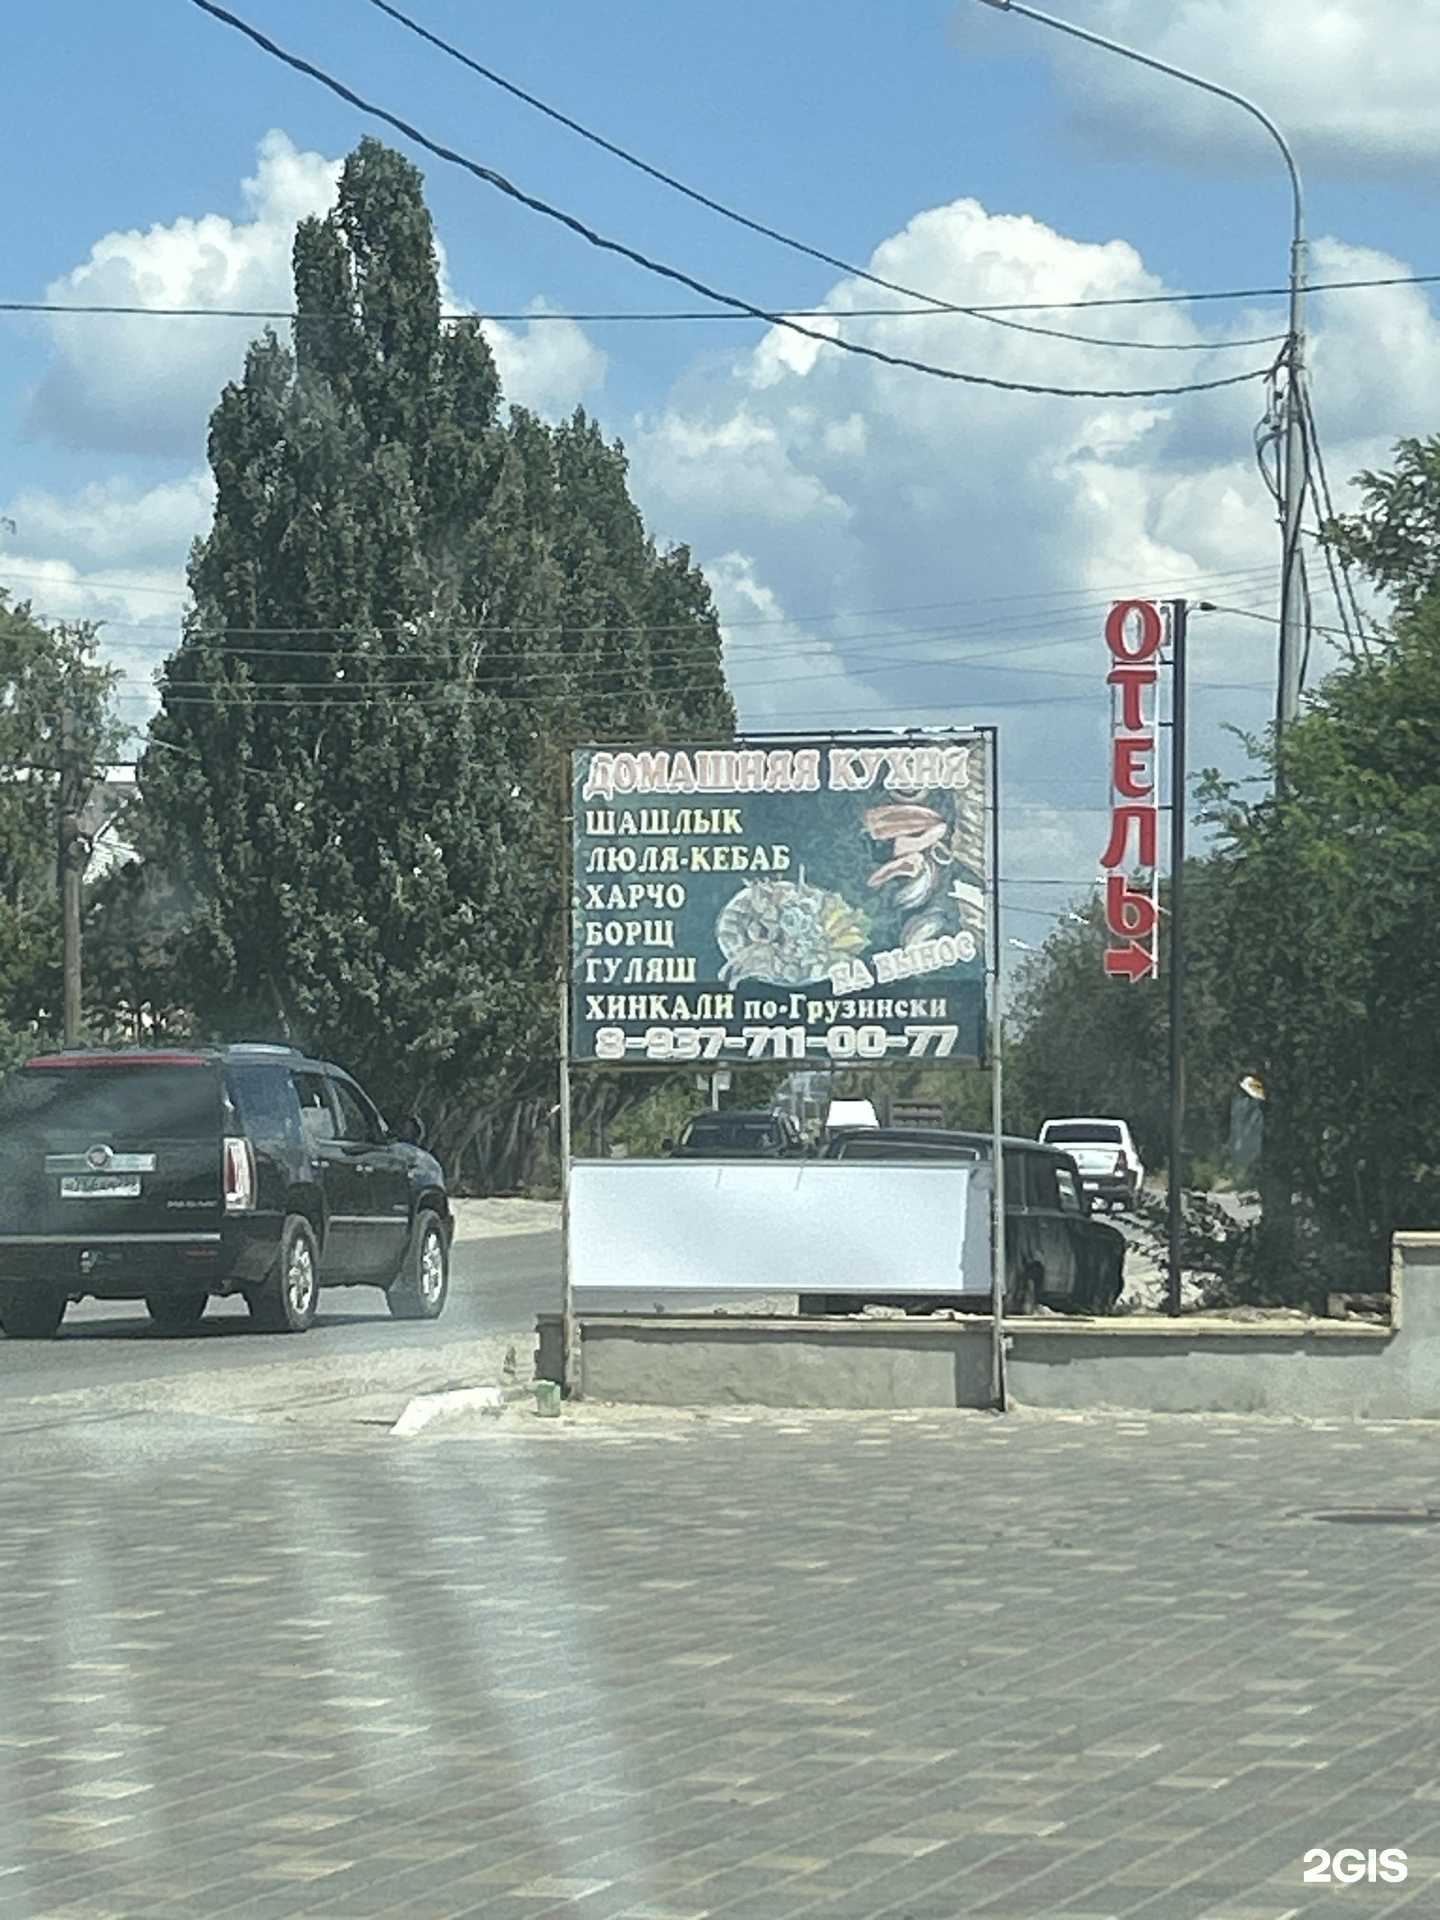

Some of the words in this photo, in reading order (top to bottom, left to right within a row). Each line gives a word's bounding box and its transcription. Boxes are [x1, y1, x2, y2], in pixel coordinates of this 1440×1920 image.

[583, 750, 820, 800] ДОМАШНЯЯ
[829, 748, 970, 790] КУХНЯ
[1100, 600, 1161, 938] ОТЕЛЬ
[585, 808, 743, 836] ШАШЛЫК
[585, 846, 791, 872] ЛЮЛЯ-КЕБАБ
[585, 884, 686, 909] ХАРЧО
[585, 920, 674, 949] БОРЩ
[585, 957, 697, 984] ГУЛЯШ
[828, 959, 875, 996] НА
[872, 931, 976, 984] ВЫНОС
[585, 994, 735, 1020] ХИНКАЛИ
[743, 994, 948, 1024] по-Грузински
[595, 1025, 959, 1060] 8-937-711-00-77
